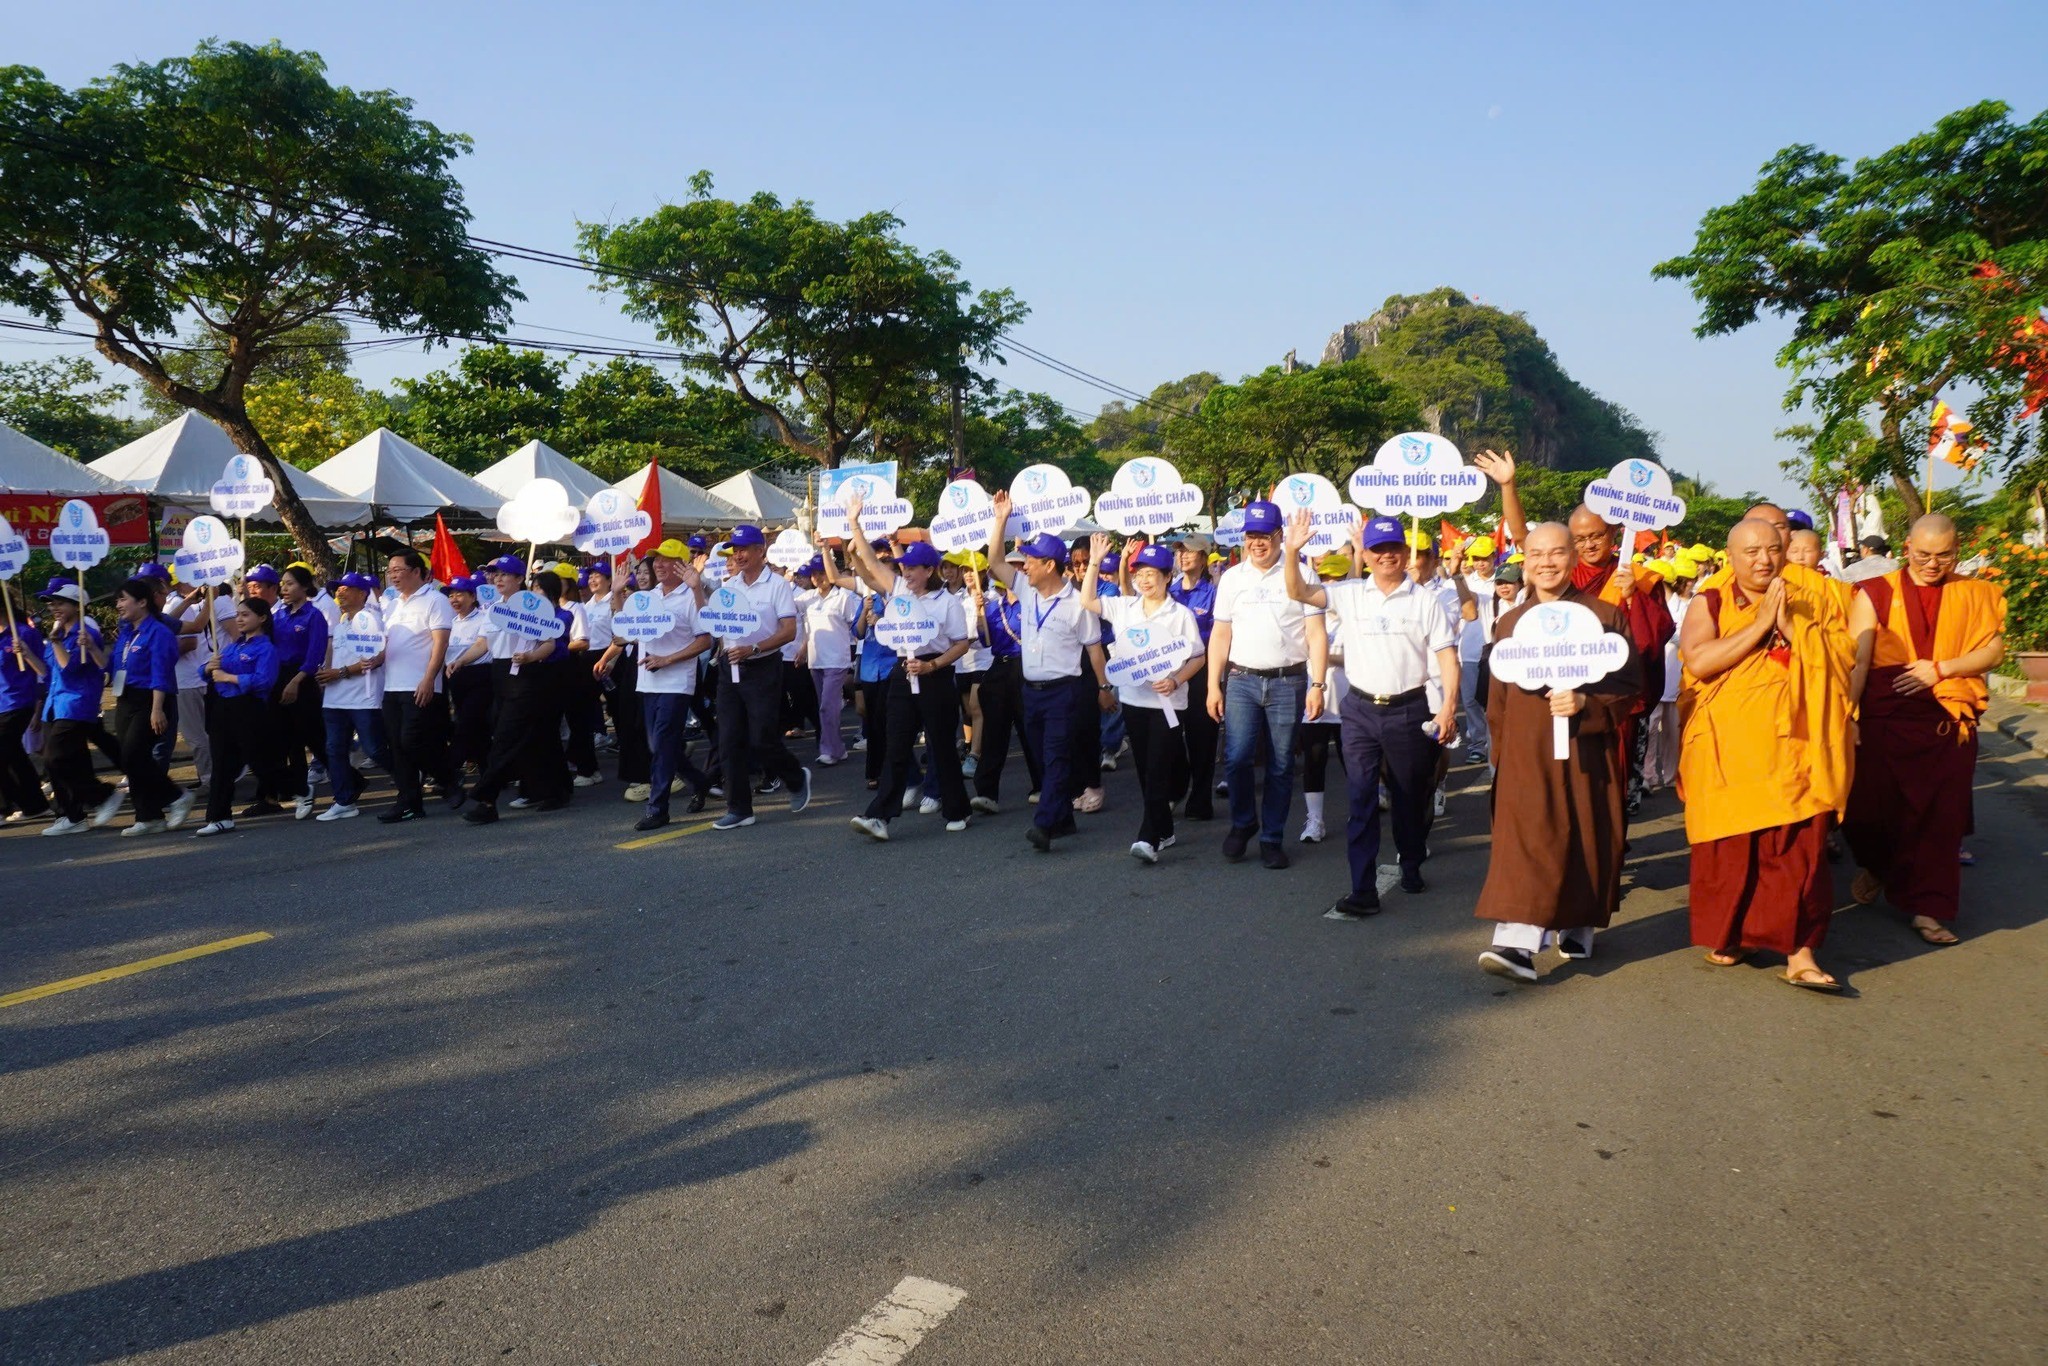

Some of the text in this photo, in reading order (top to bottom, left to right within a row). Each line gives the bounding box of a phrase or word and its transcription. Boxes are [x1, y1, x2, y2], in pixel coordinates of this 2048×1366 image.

[1355, 468, 1477, 487] NHỮNG BƯỚC CHÂN
[1099, 489, 1195, 511] NHỮNG BƯỚC CHÂN
[1385, 493, 1448, 507] HÒA BÌNH
[1590, 483, 1680, 513] NHỮNG BƯỚC CHÂN
[822, 501, 907, 518] NHỮN ƯỚC CHÂN
[1325, 509, 1354, 525] CHÂN
[1609, 505, 1656, 525] HÒA BÌNH
[865, 521, 887, 531] BÌNH
[1124, 511, 1174, 527] HÒA BÌNH
[1496, 637, 1618, 660] NHỮNG BƯỚC CHÂN
[1526, 664, 1589, 679] HÒA BÌNH
